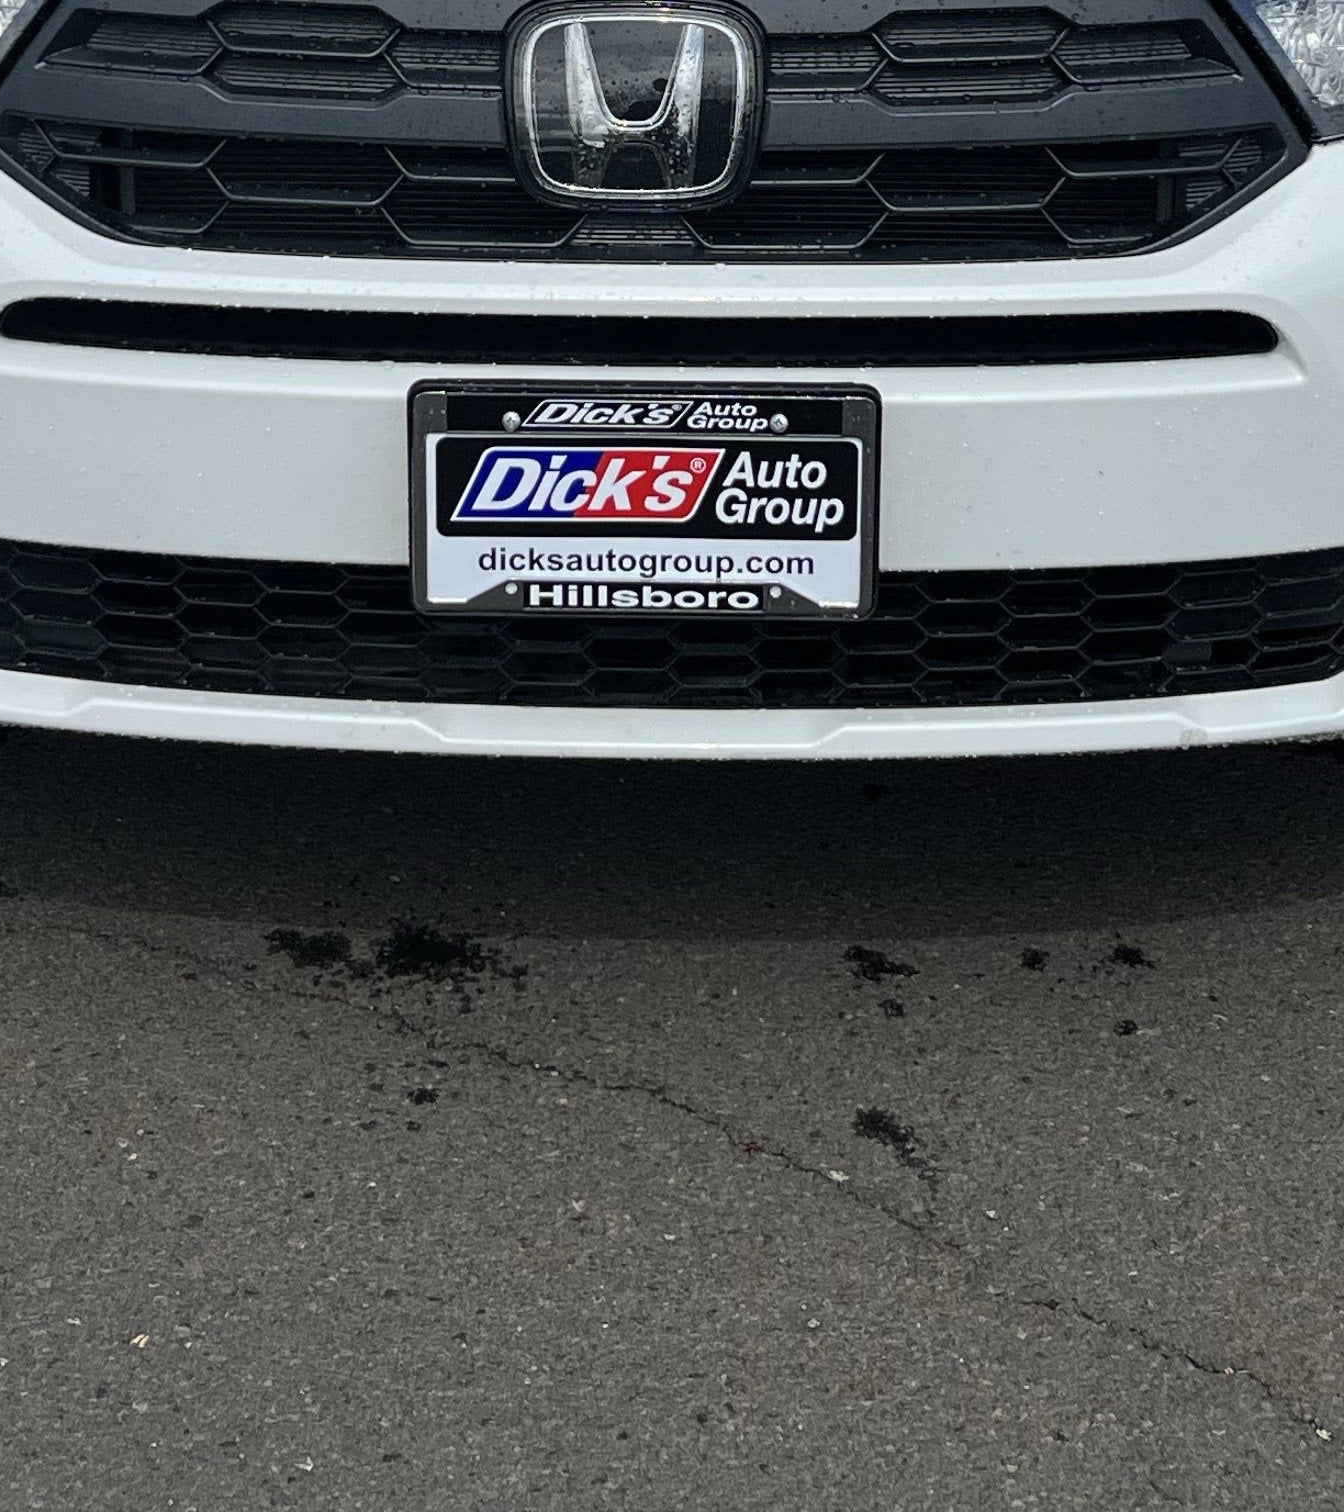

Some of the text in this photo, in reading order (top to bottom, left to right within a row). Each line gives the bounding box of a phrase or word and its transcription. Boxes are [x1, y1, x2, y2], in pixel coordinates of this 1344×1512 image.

[534, 402, 674, 425] Dick's
[693, 401, 758, 416] Auto
[686, 414, 769, 433] Group
[471, 454, 694, 513] Dick's
[722, 451, 828, 488] Auto
[715, 488, 845, 533] Group
[477, 547, 815, 578] dicksautogroup.com
[528, 584, 760, 609] Hillsboro
